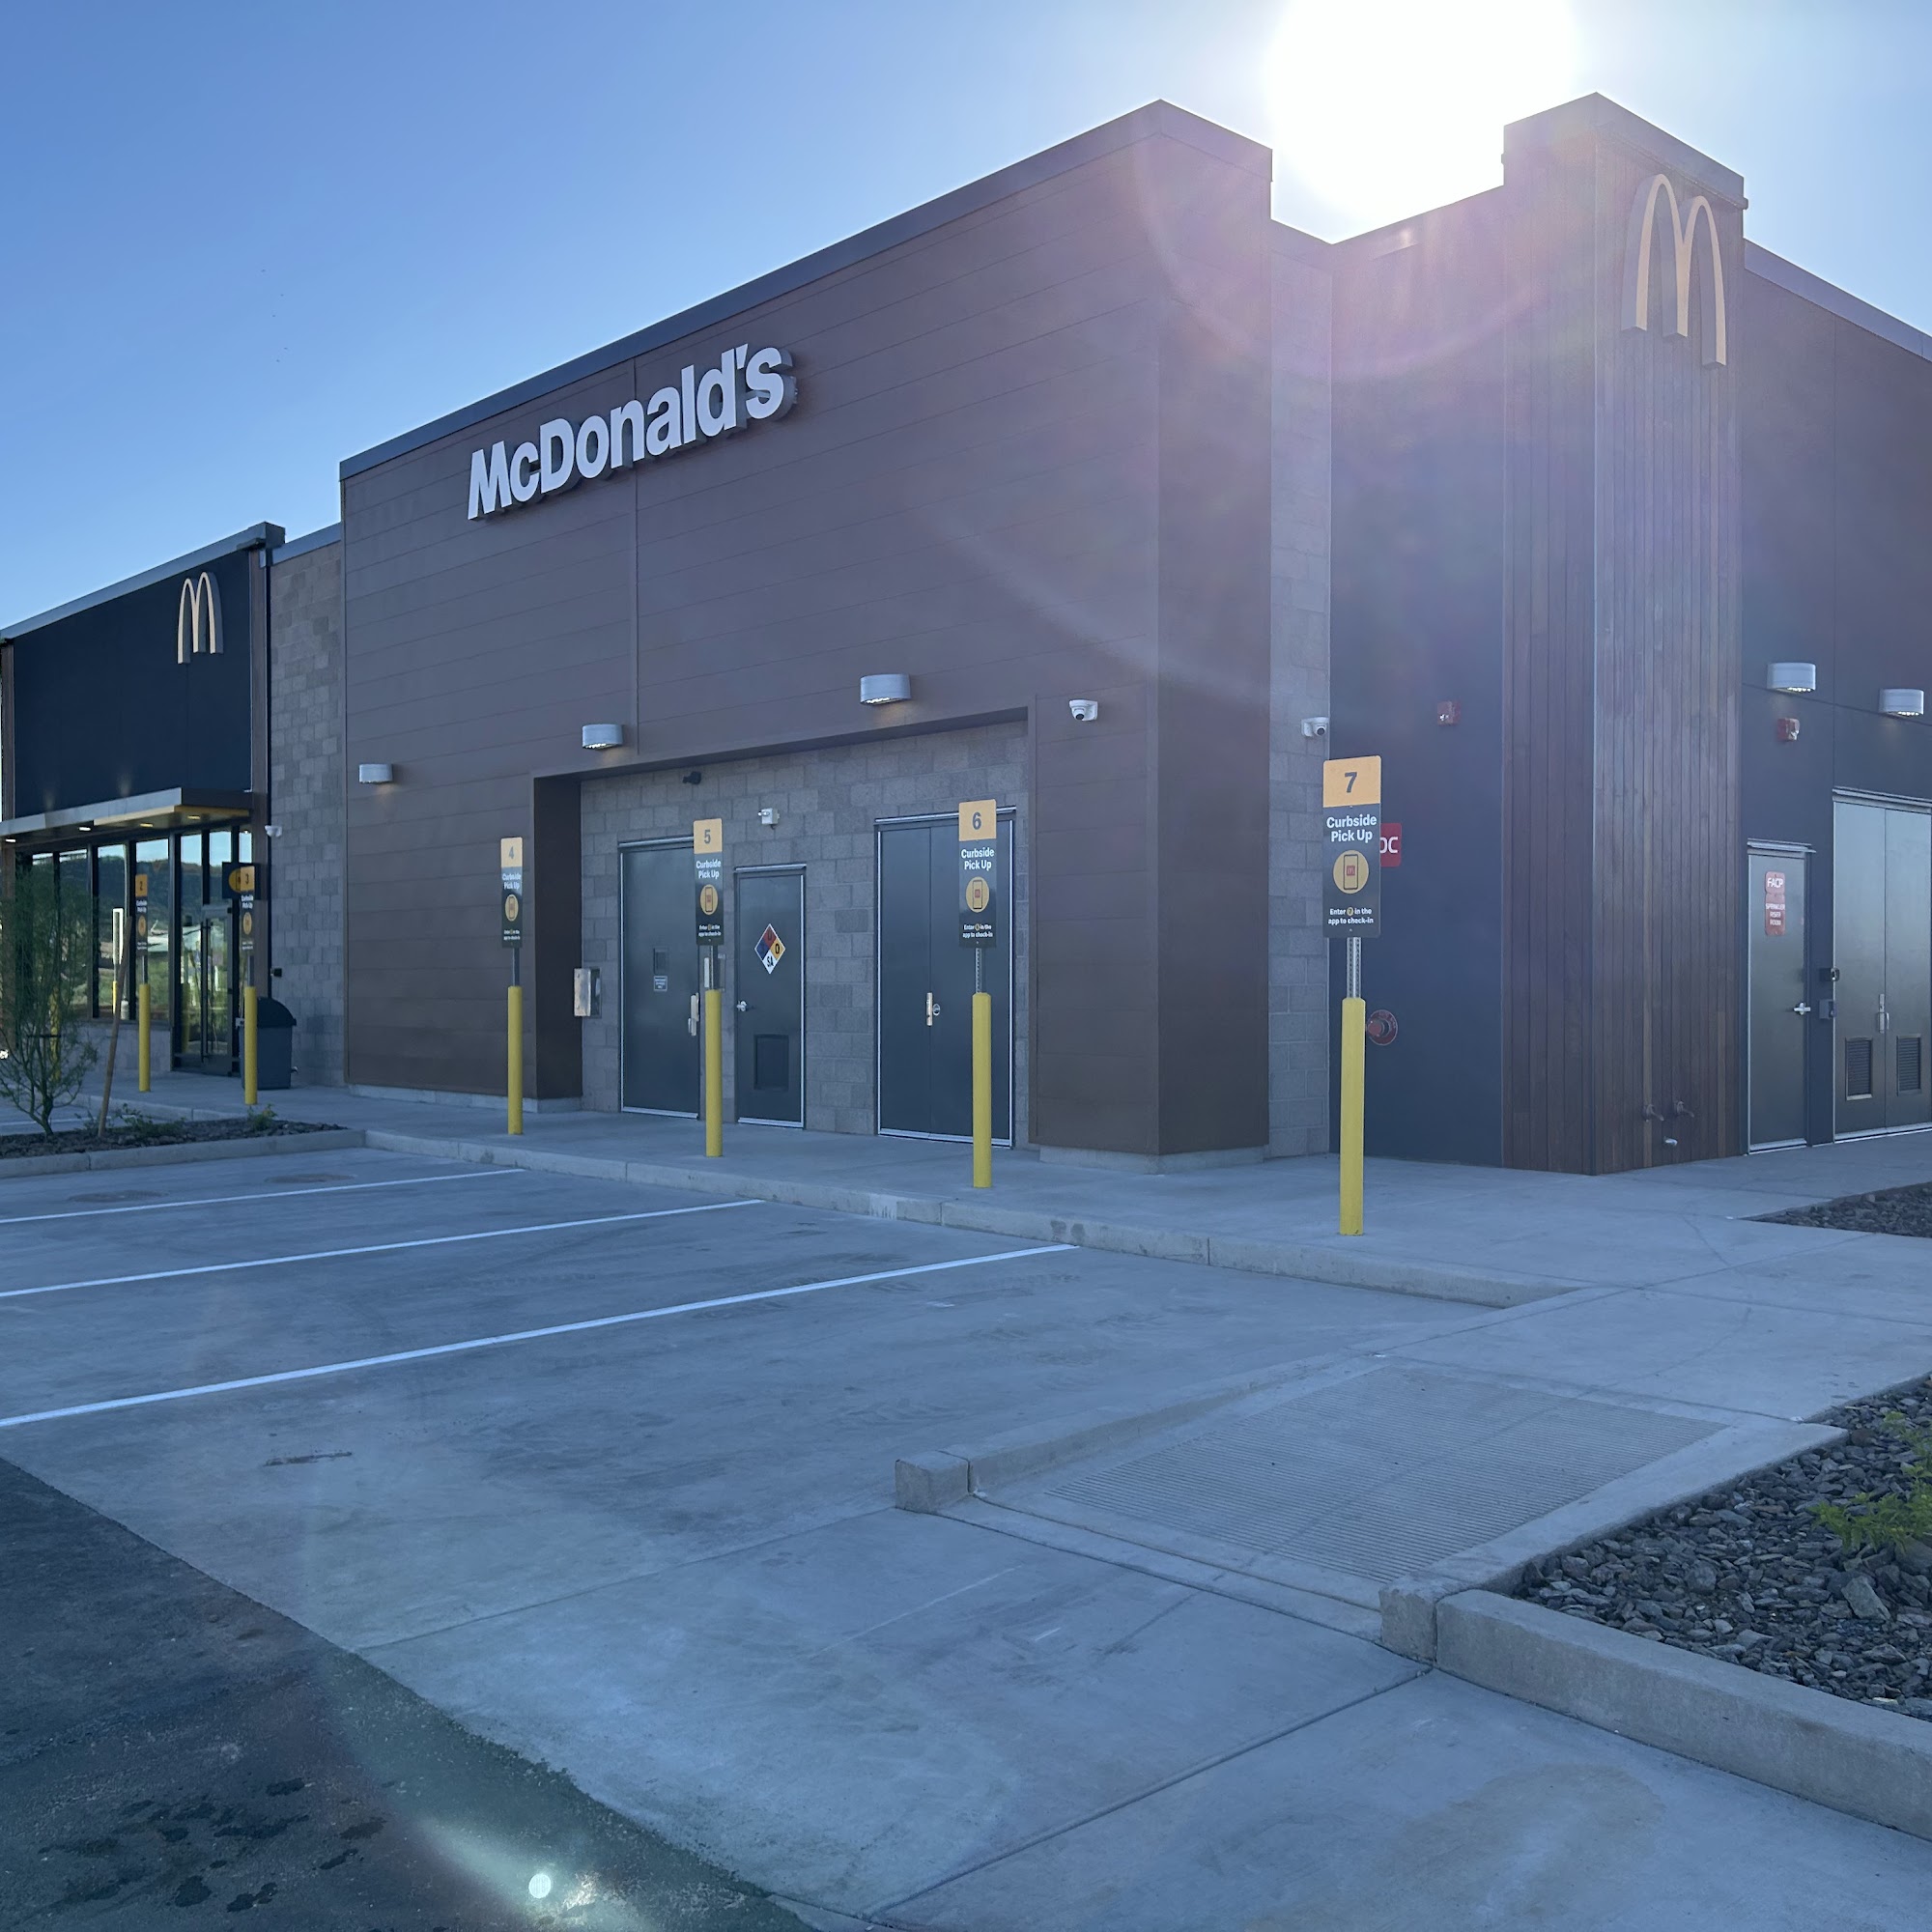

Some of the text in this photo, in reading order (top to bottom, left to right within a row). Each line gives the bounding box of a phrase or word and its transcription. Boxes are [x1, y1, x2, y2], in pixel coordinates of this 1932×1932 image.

[468, 343, 786, 520] McDonald's
[1345, 772, 1357, 793] 7
[972, 811, 981, 830] 6
[1326, 813, 1377, 829] Curbside
[704, 829, 711, 844] 5
[1331, 829, 1373, 843] Pick Up
[508, 846, 514, 859] 4
[961, 847, 995, 859] Curbside
[696, 859, 722, 868] Curbside
[964, 859, 992, 871] Pick Up
[698, 869, 720, 879] Pick Up
[1767, 877, 1783, 888] FACP
